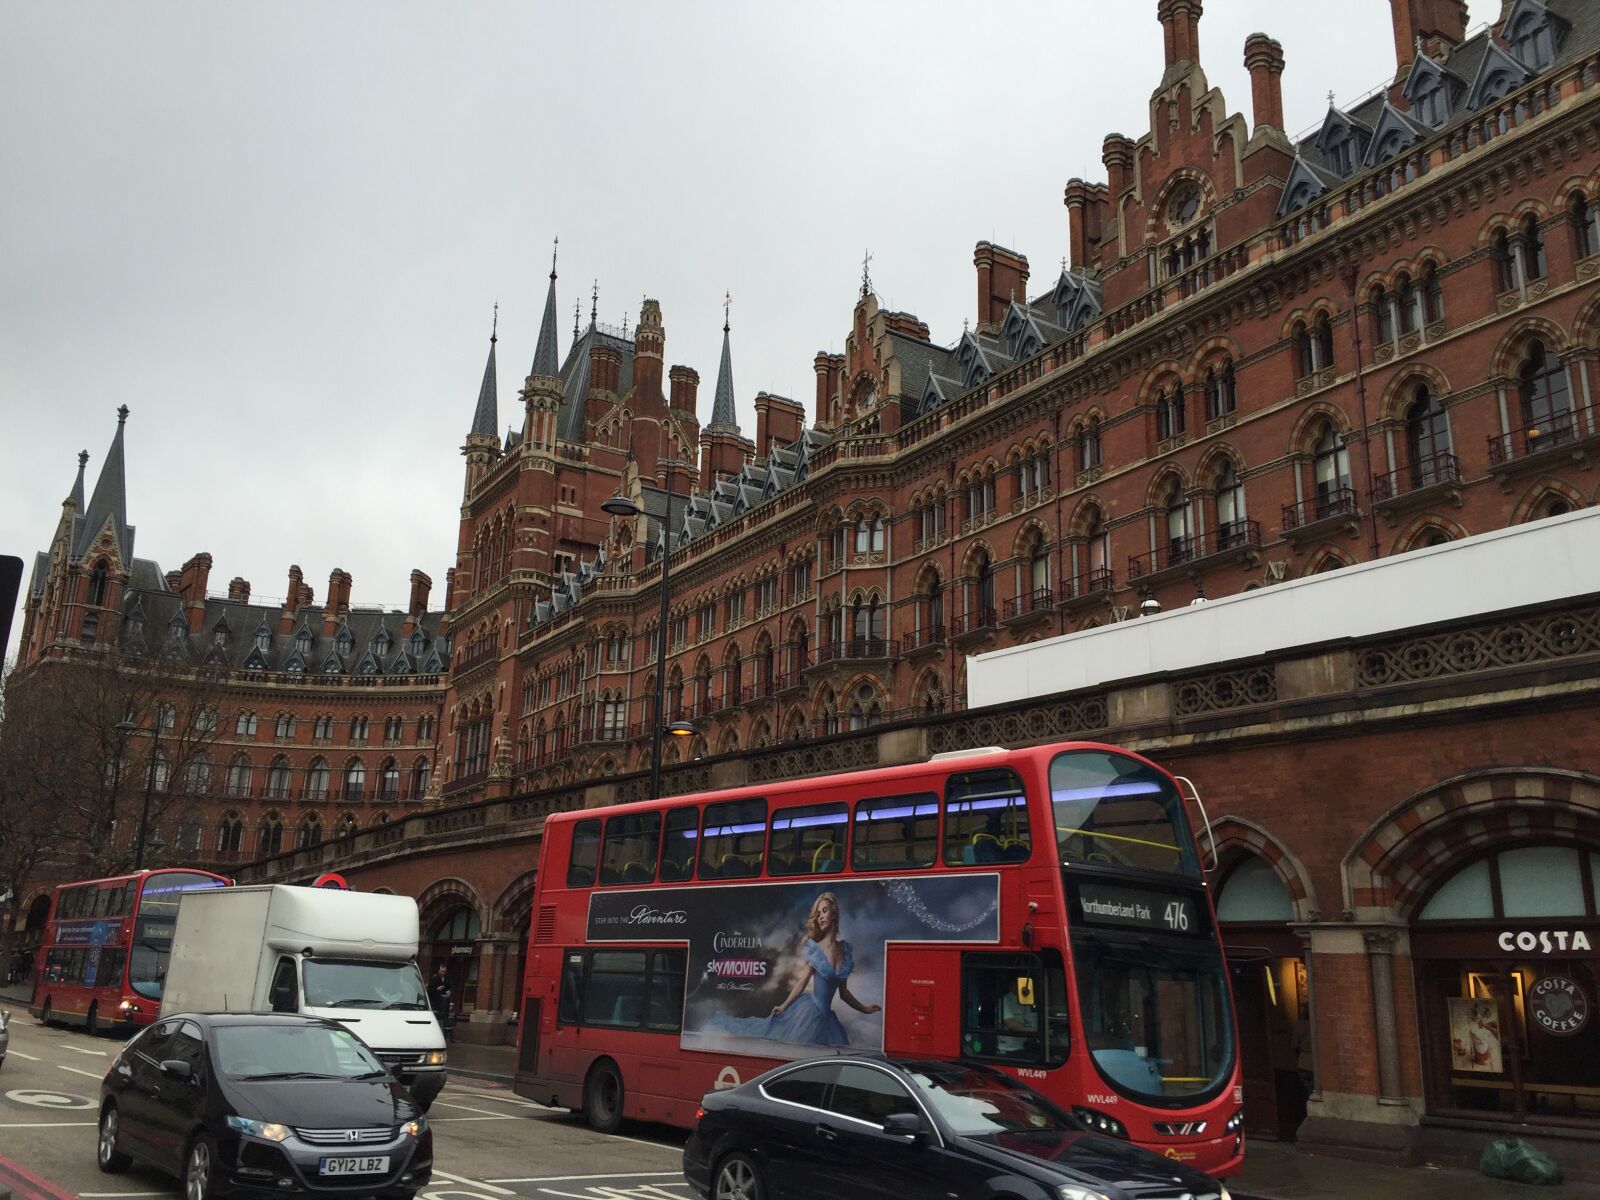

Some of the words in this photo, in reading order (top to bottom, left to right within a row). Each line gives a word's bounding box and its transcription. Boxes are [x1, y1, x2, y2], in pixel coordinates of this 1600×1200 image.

[628, 904, 687, 924] Adventure
[1080, 897, 1135, 918] Northumberland
[1136, 904, 1151, 920] Park
[1164, 902, 1188, 930] 476
[713, 931, 762, 953] CINDERELLA
[1498, 931, 1591, 953] COSTA
[1536, 979, 1575, 995] COSTA
[1536, 1010, 1583, 1030] COFFEE
[1017, 1068, 1047, 1079] WVL449
[1087, 1094, 1118, 1104] WVL449
[328, 1160, 357, 1172] GY12
[358, 1158, 382, 1171] LBZ
